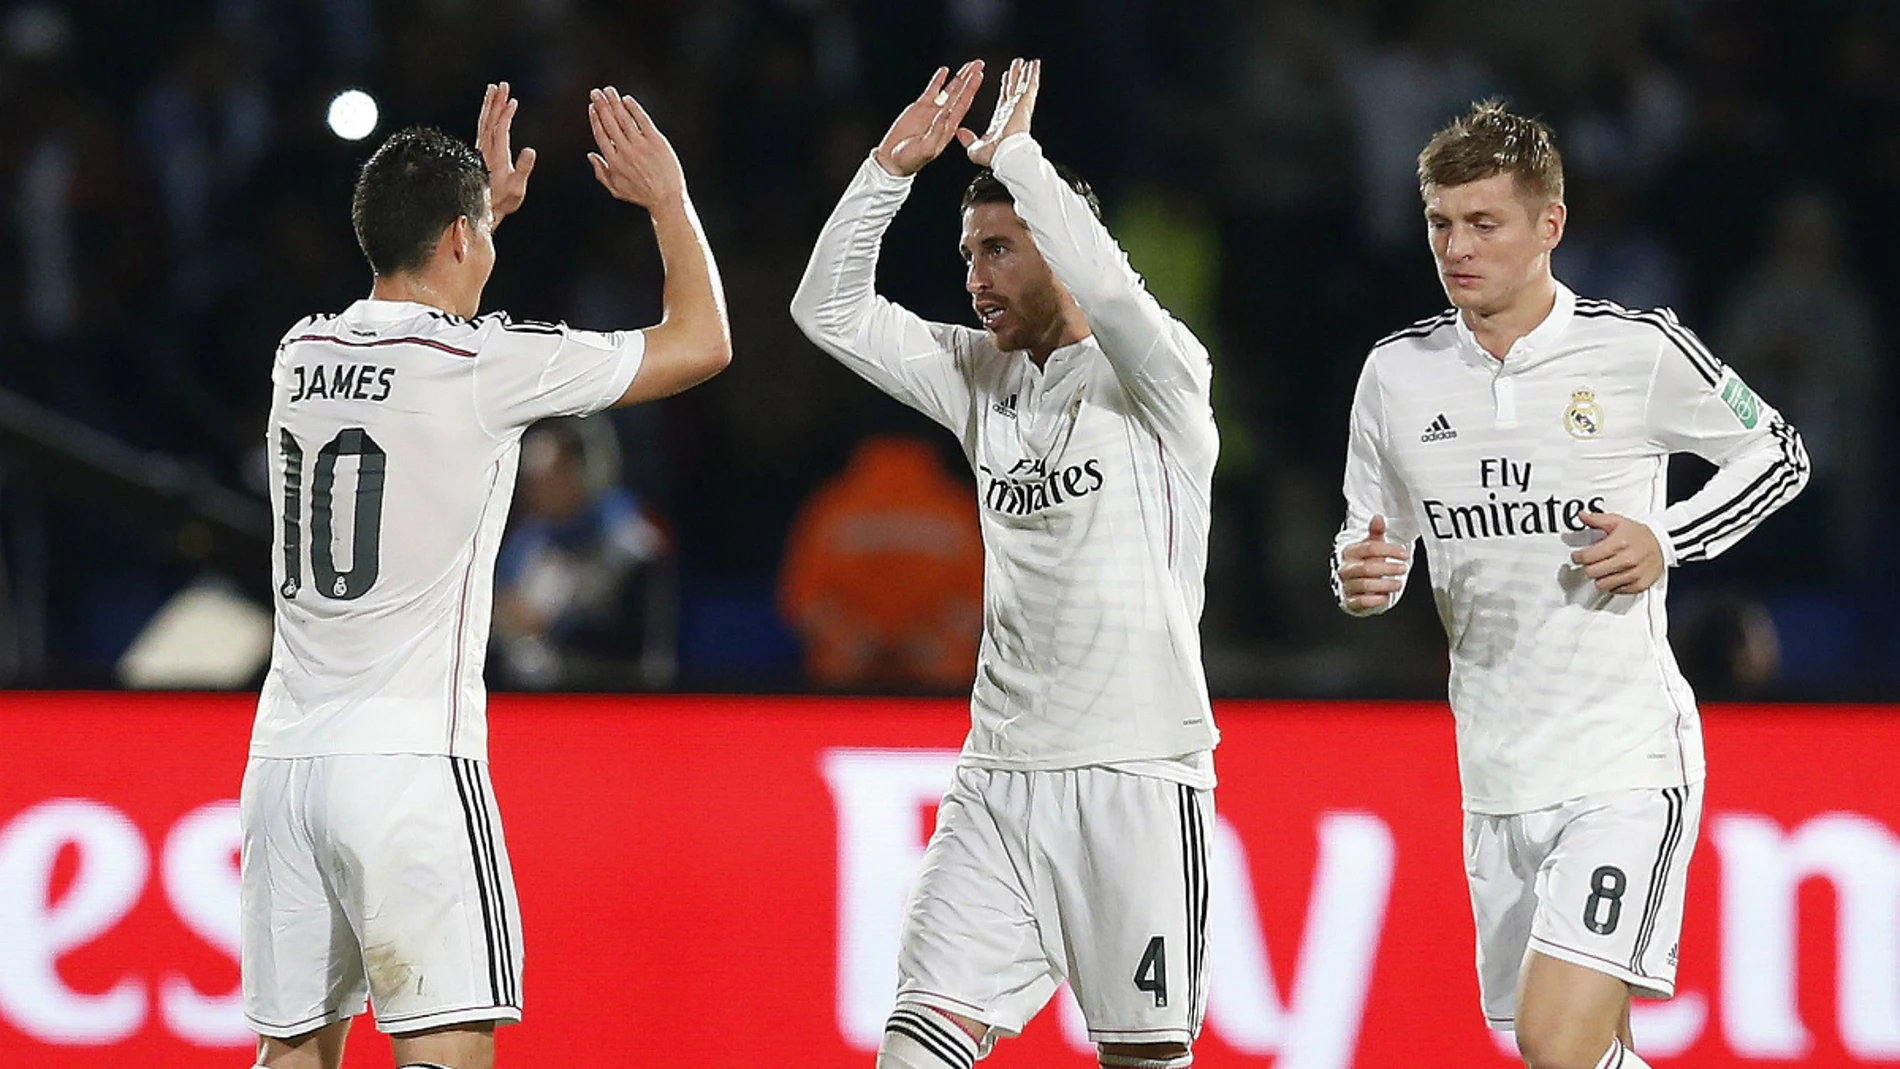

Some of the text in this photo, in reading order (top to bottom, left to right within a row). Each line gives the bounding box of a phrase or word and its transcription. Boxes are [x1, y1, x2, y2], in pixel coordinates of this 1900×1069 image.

[290, 364, 396, 402] JAMES
[1421, 430, 1458, 443] adidas
[979, 459, 1104, 515] mirates
[1480, 457, 1532, 492] Fly
[279, 426, 387, 600] 10
[1422, 492, 1606, 539] Emirates
[818, 746, 1396, 1069] Fy
[1583, 865, 1627, 936] 8
[1133, 936, 1168, 1008] 4
